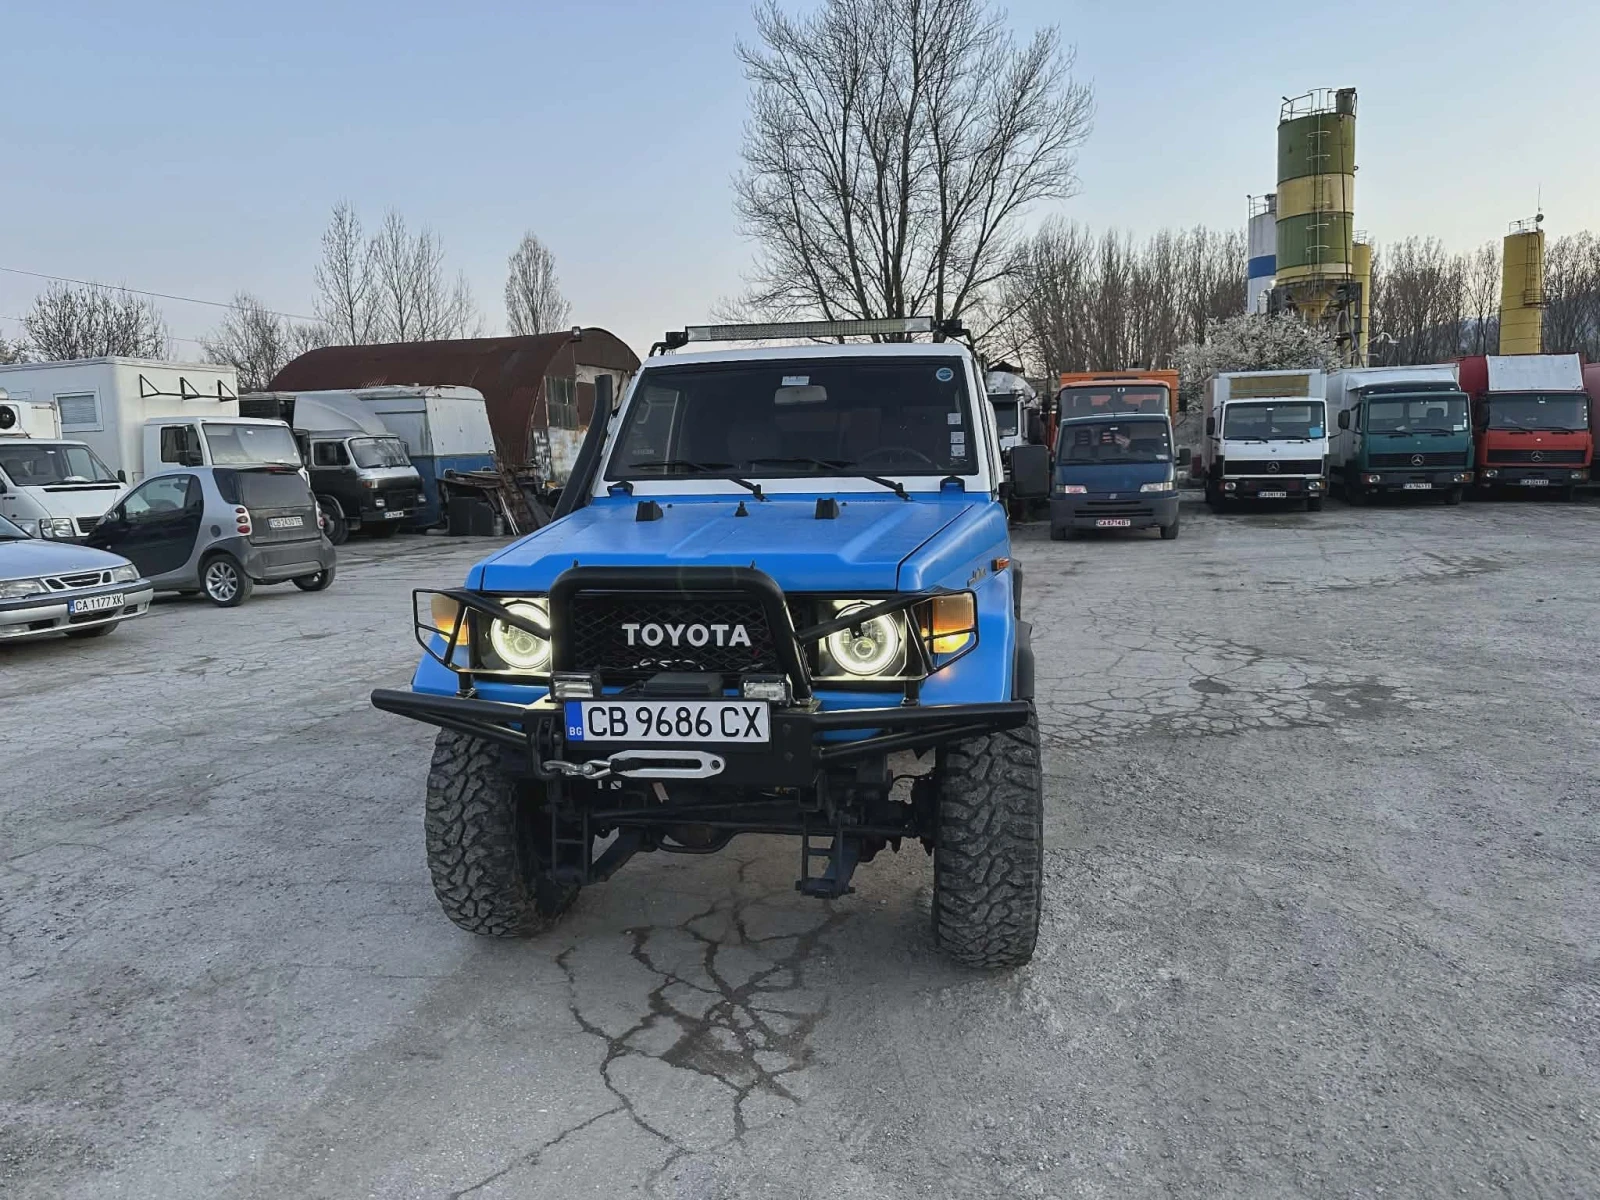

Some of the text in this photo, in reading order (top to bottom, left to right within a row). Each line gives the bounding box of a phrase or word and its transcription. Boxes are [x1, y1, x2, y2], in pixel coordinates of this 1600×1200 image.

[75, 595, 122, 611] CA 1177 XK
[621, 623, 752, 647] TOYOTA
[569, 727, 582, 736] BG
[587, 706, 762, 738] CB 9686 CX
